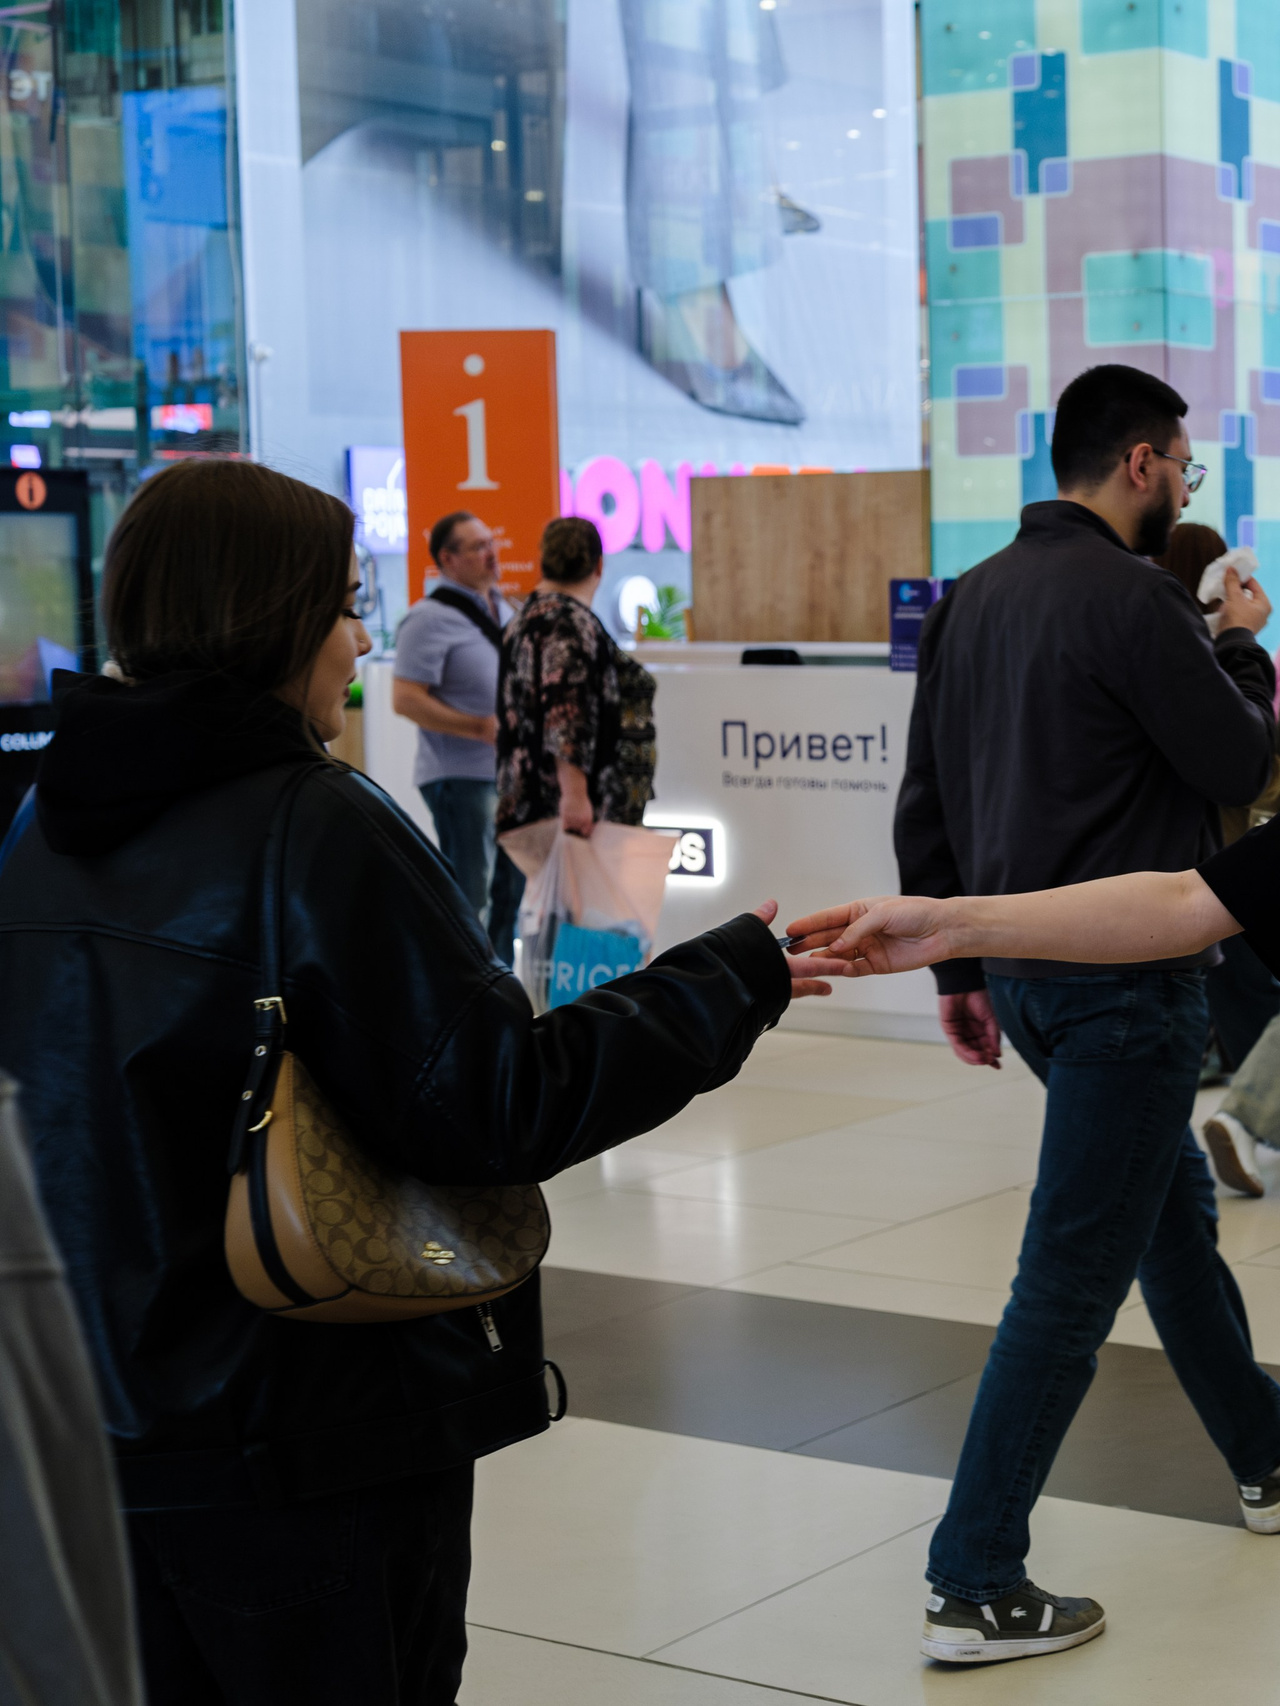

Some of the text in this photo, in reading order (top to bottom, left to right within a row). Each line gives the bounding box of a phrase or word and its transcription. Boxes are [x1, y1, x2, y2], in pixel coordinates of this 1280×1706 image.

[722, 720, 888, 769] Привет!
[722, 771, 773, 789] Всегда
[777, 774, 827, 790] готовы
